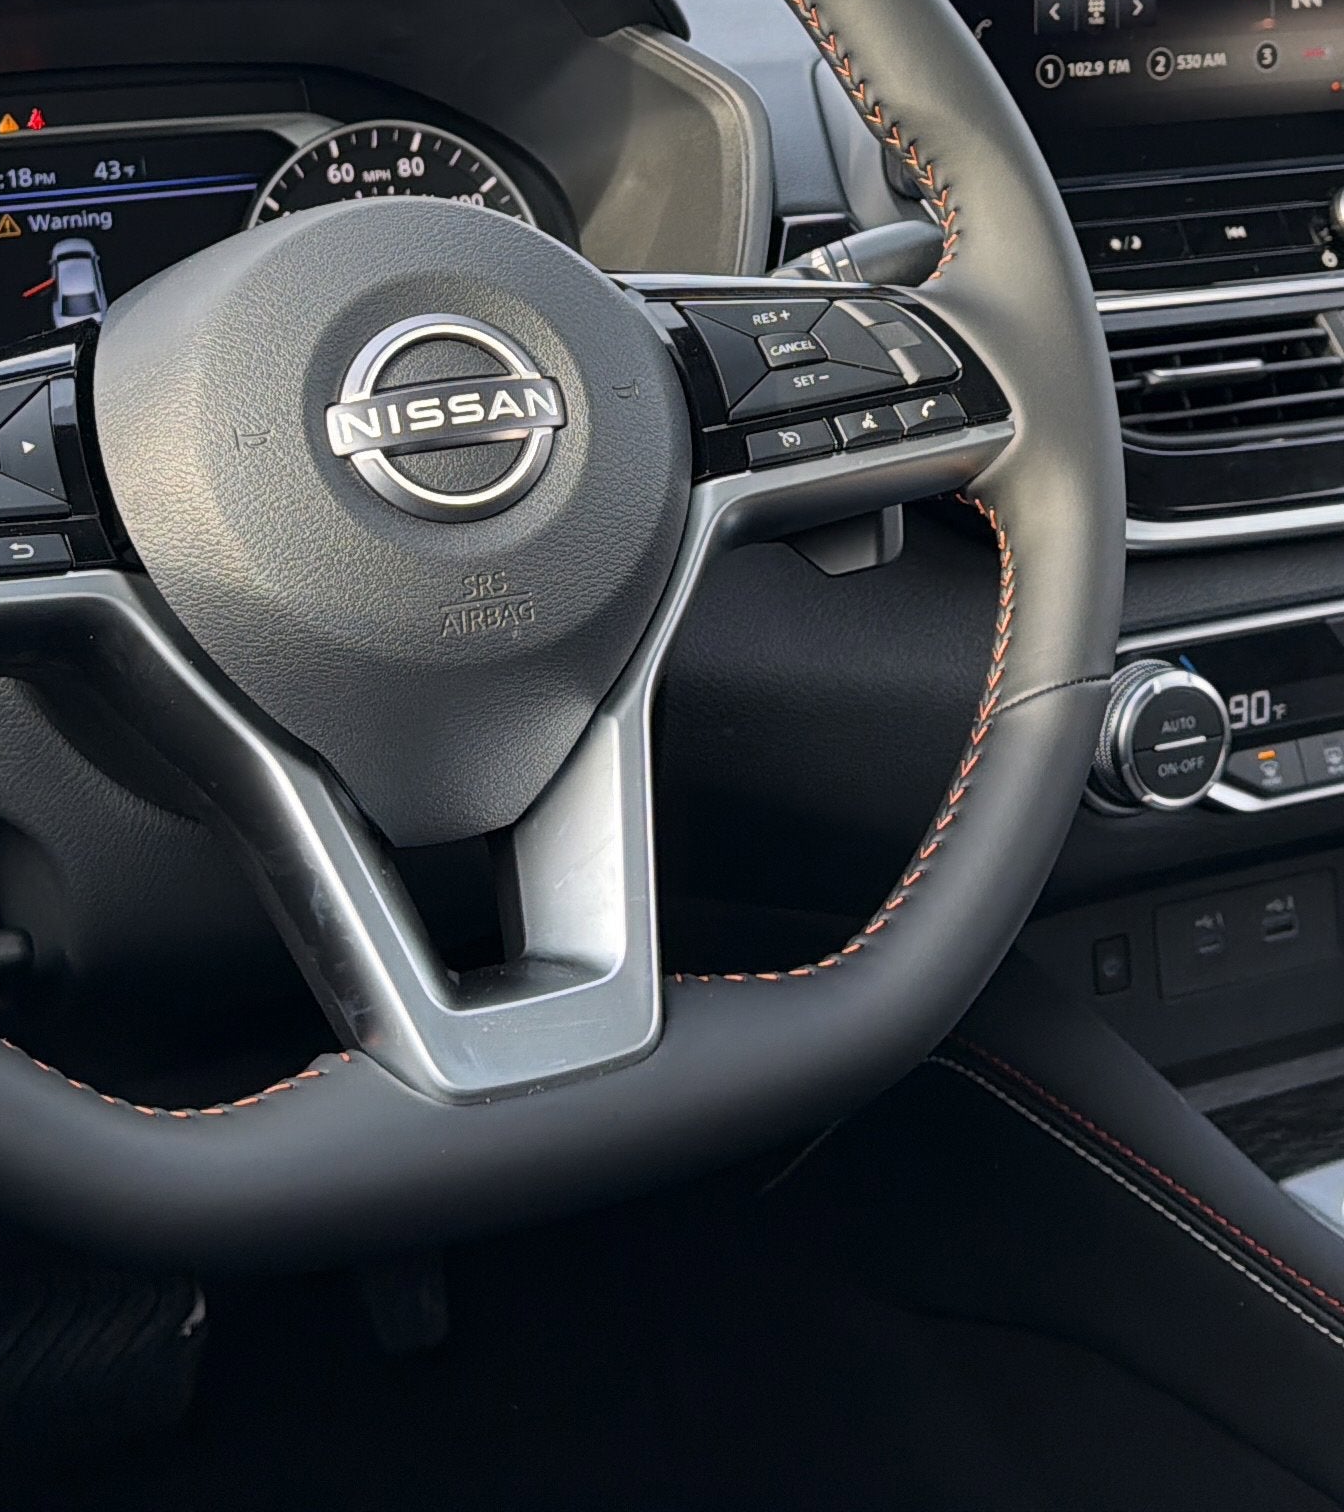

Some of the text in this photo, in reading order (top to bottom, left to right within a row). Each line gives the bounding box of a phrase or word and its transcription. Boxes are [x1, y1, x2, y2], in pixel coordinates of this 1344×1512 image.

[1067, 61, 1104, 78] 102.9
[1108, 58, 1131, 75] FM
[1176, 54, 1202, 70] 530
[1204, 52, 1227, 68] AM
[327, 162, 355, 185] 60
[362, 168, 392, 184] MPH
[397, 156, 425, 178] 80
[27, 210, 113, 232] Warning
[752, 311, 778, 326] RES
[770, 338, 816, 357] CANCEL
[792, 373, 815, 388] SET
[339, 388, 559, 444] NISSAN
[461, 571, 508, 597] SRS
[439, 600, 536, 638] AIRBAG
[1161, 715, 1196, 734] AUTO
